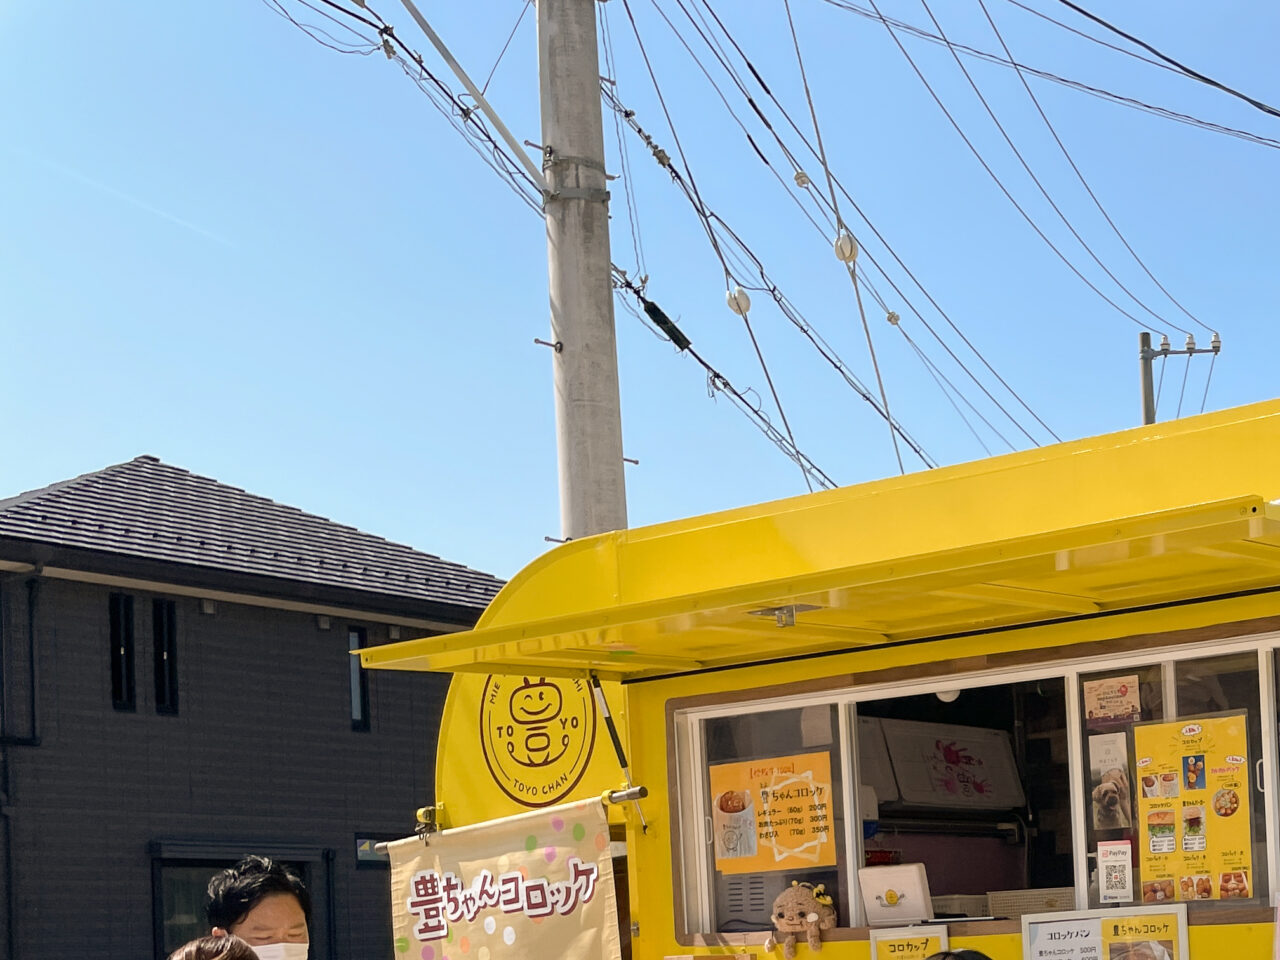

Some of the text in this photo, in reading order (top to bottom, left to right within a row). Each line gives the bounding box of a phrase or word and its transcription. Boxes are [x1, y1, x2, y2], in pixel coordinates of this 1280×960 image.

[513, 772, 568, 796] TOYO CHAN
[408, 860, 599, 942] 豊ちゃんコロッケ
[1047, 930, 1090, 940] コロッケパン
[1112, 924, 1169, 937] 豊ちゃんコロッケ
[888, 938, 929, 952] コロカップ
